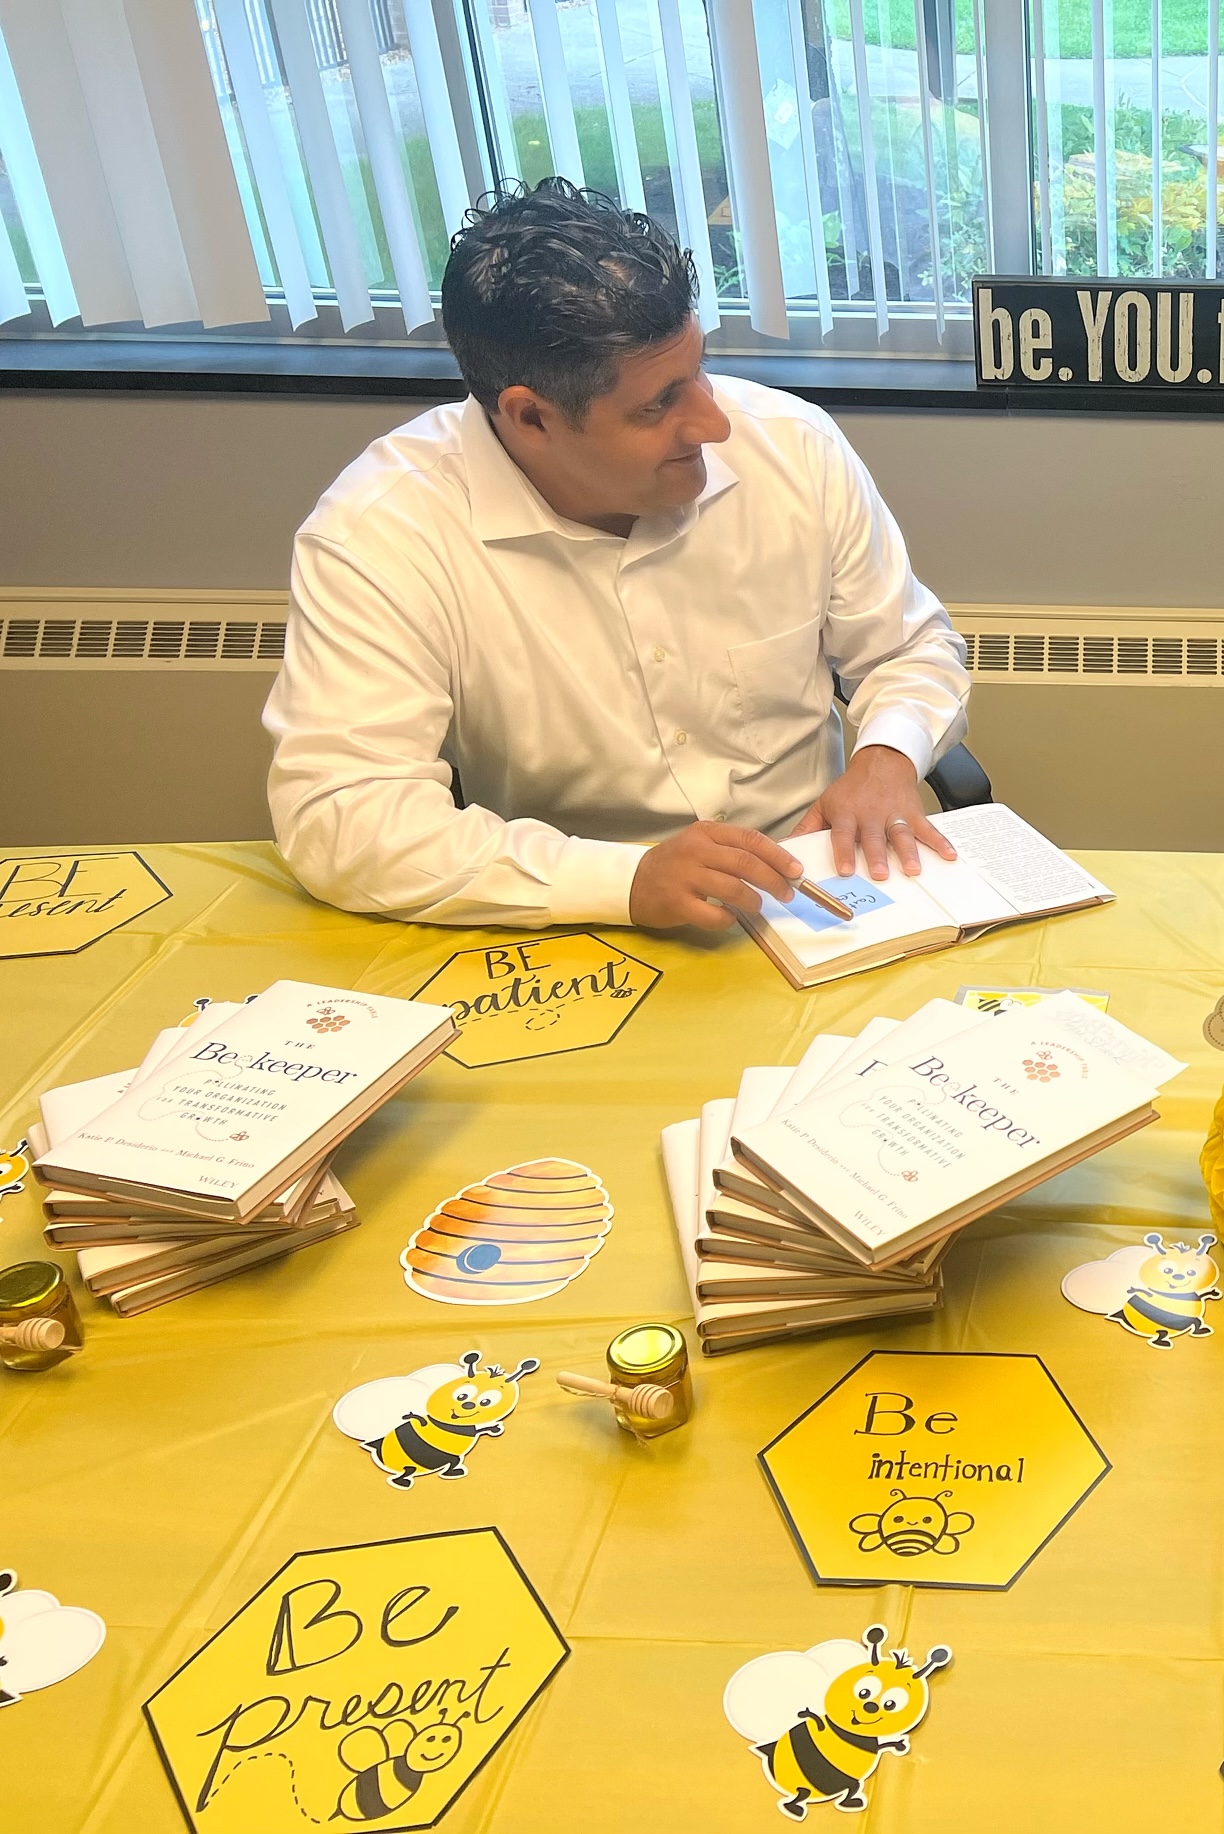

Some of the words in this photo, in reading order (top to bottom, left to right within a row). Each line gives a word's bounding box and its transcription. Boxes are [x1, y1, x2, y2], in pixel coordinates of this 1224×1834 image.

[0, 857, 119, 902] BE
[0, 889, 127, 918] esent
[484, 942, 551, 980] BE
[189, 1041, 358, 1085] Beekeeper
[284, 1040, 317, 1050] THE
[172, 1085, 202, 1096] YOUR
[204, 1091, 288, 1111] ORGANIZATION
[908, 1055, 1041, 1149] Beekeeper
[992, 1077, 1020, 1096] THE
[178, 1098, 279, 1122] TRANSFORMATIVE
[879, 1095, 902, 1113] YOUR
[902, 1108, 966, 1160] ORGANIZATION
[77, 1132, 103, 1141] Katie
[115, 1138, 159, 1152] Desiderio
[175, 1149, 215, 1161] Michael
[227, 1158, 255, 1169] Frino
[877, 1113, 953, 1169] TRANSFORMATIVE
[198, 1175, 240, 1189] WILEY
[807, 1138, 839, 1165] Desiderio
[850, 1172, 880, 1196] Michael
[887, 1201, 908, 1219] Frino
[854, 1210, 887, 1236] WILEY
[854, 1392, 958, 1436] Be
[868, 1450, 1024, 1483] intentional
[266, 1578, 459, 1677] Be
